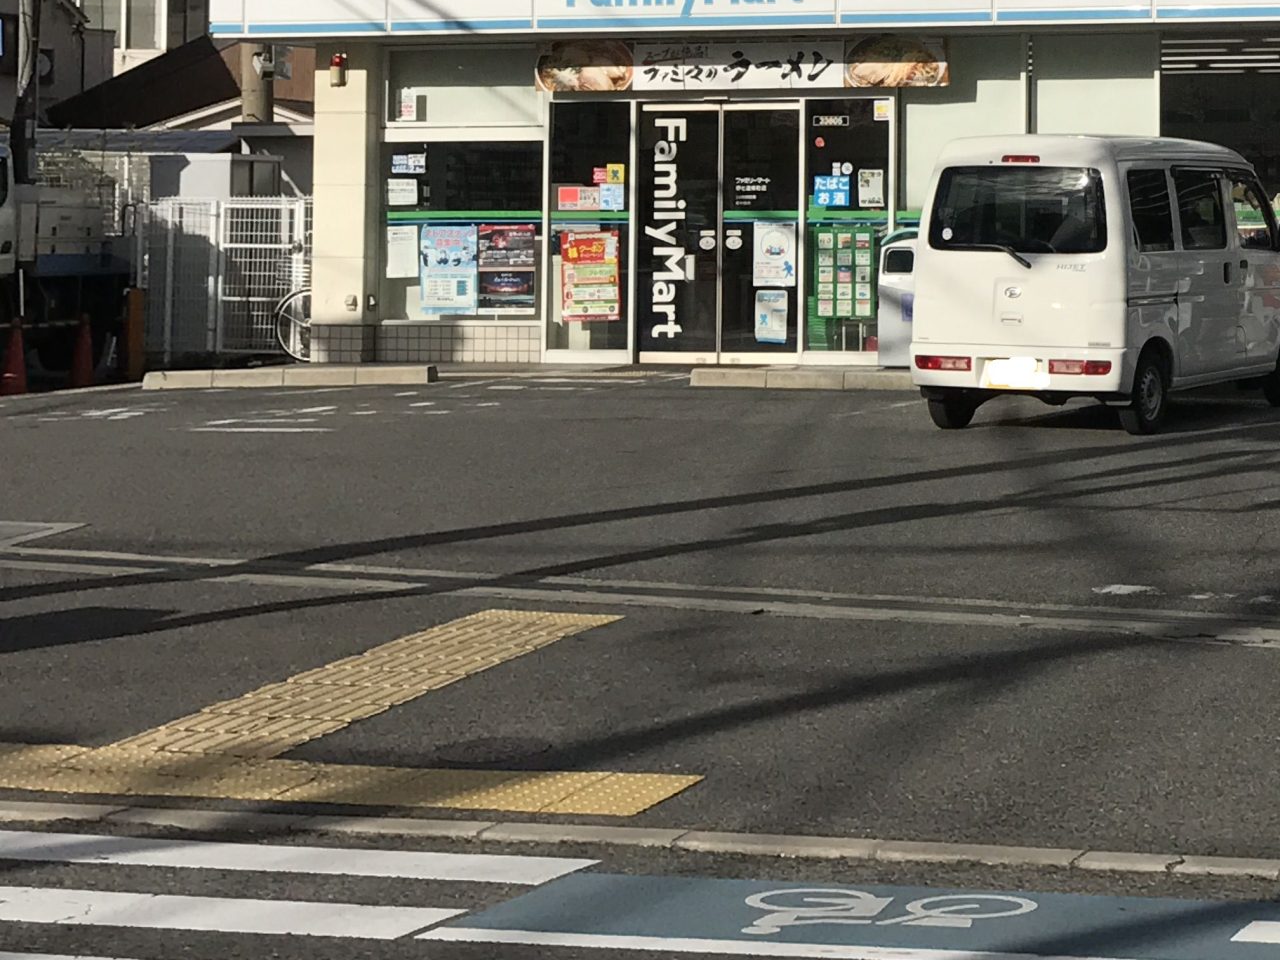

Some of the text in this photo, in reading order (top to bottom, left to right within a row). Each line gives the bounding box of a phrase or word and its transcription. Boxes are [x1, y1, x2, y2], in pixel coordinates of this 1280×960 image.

[815, 178, 849, 190] たばこ
[818, 192, 846, 205] お酒
[645, 118, 687, 338] FamilyMart
